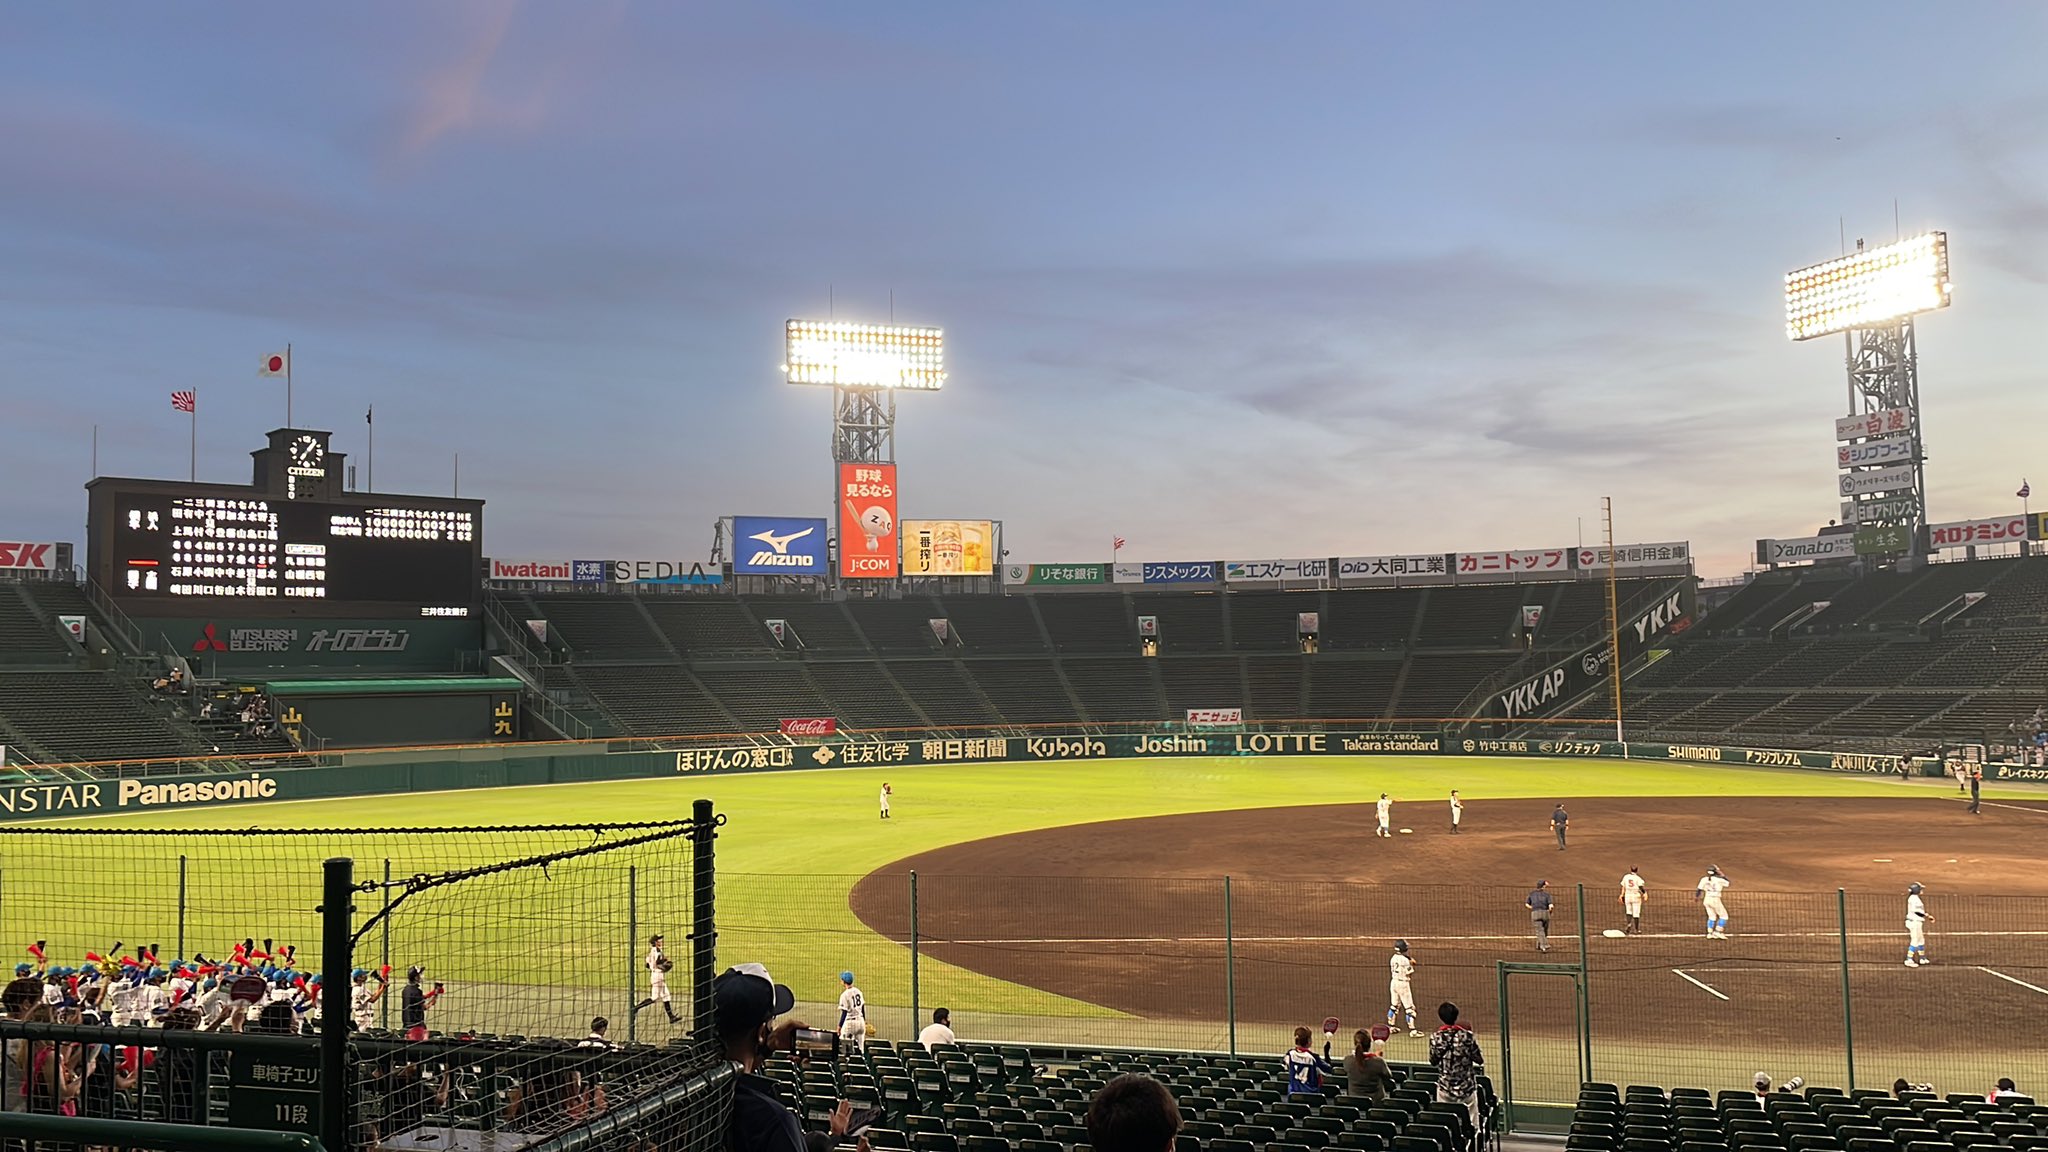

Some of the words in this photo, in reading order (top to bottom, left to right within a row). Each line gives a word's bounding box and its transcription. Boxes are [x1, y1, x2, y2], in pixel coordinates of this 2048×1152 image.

[1866, 410, 1906, 434] 白波
[1851, 440, 1910, 461] シノブフーズ
[287, 466, 325, 477] CITIZEN
[855, 469, 882, 483] 野球
[846, 484, 893, 498] 見るなら
[1876, 532, 1900, 547] 生茶
[1932, 519, 2026, 545] オロナミンC
[919, 530, 932, 572] 一番搾り
[1775, 541, 1834, 558] Yamato
[494, 561, 570, 578] Iwatani
[577, 562, 601, 575] 水素
[850, 559, 890, 573] J:COM
[1245, 561, 1327, 578] エスケー化研
[1371, 556, 1445, 575] 大同工業
[1460, 550, 1563, 572] カニトップ
[615, 560, 707, 581] SEDIA
[1040, 567, 1098, 581] りそな銀行
[1145, 565, 1213, 580] シスメックス
[1634, 592, 1681, 643] YKK
[230, 629, 298, 641] MITSUBISHI
[230, 641, 289, 651] ELECTRIC
[495, 702, 513, 735] 山九
[1189, 711, 1240, 722] 不二サッシ
[922, 739, 1007, 761] 朝日新聞
[1027, 738, 1107, 757] Kubota
[1134, 736, 1207, 754] Joshin
[1236, 734, 1327, 752] LOTTE
[1341, 738, 1382, 751] Takara
[1383, 738, 1440, 752] standard
[1480, 741, 1528, 753] 竹中工務店
[676, 747, 786, 771] ほけんの窓口
[839, 743, 910, 764] 住友化学
[1668, 745, 1721, 760] SHIMANO
[118, 774, 277, 806] Panasonic
[1628, 879, 1635, 888] 5
[851, 993, 862, 1008] 18
[252, 1064, 321, 1084] 車椅子エリ
[275, 1104, 308, 1124] 11段
